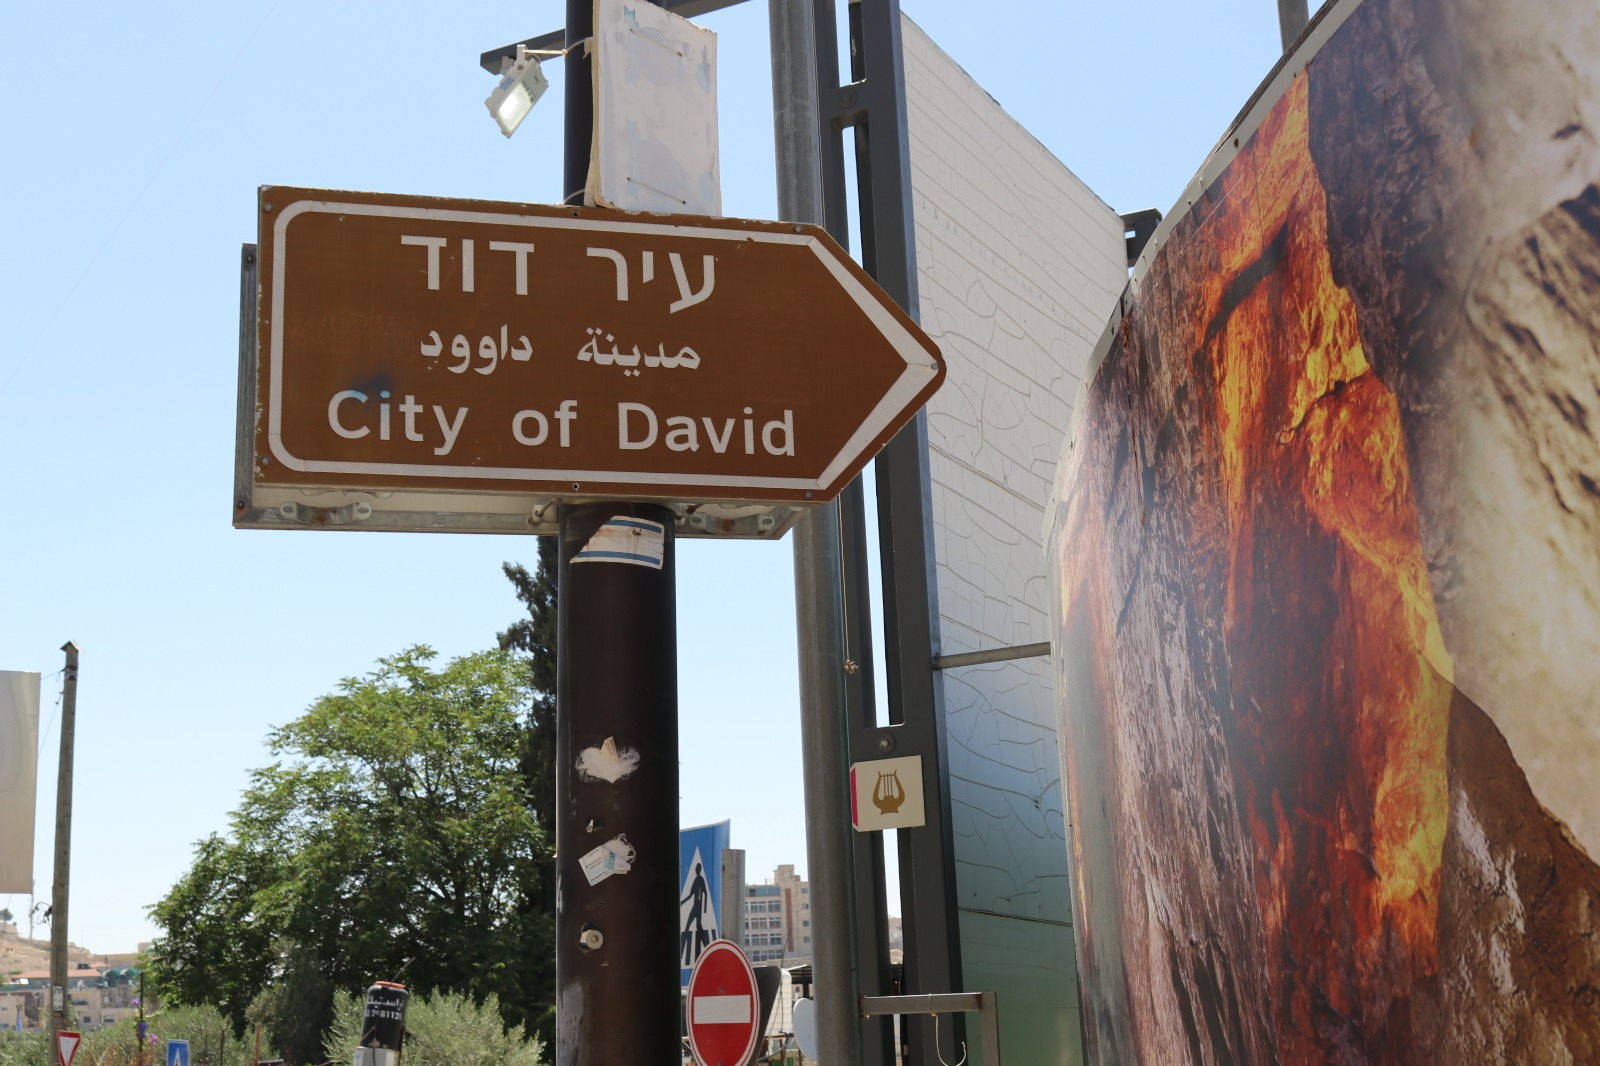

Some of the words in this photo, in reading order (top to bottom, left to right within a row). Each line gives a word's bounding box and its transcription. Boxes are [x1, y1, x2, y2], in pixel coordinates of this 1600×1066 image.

[400, 234, 535, 297] דוד
[586, 248, 717, 314] עיר
[420, 324, 533, 375] داوود
[577, 327, 701, 377] مدينة
[328, 389, 469, 457] City
[512, 399, 578, 448] of
[618, 401, 796, 457] David
